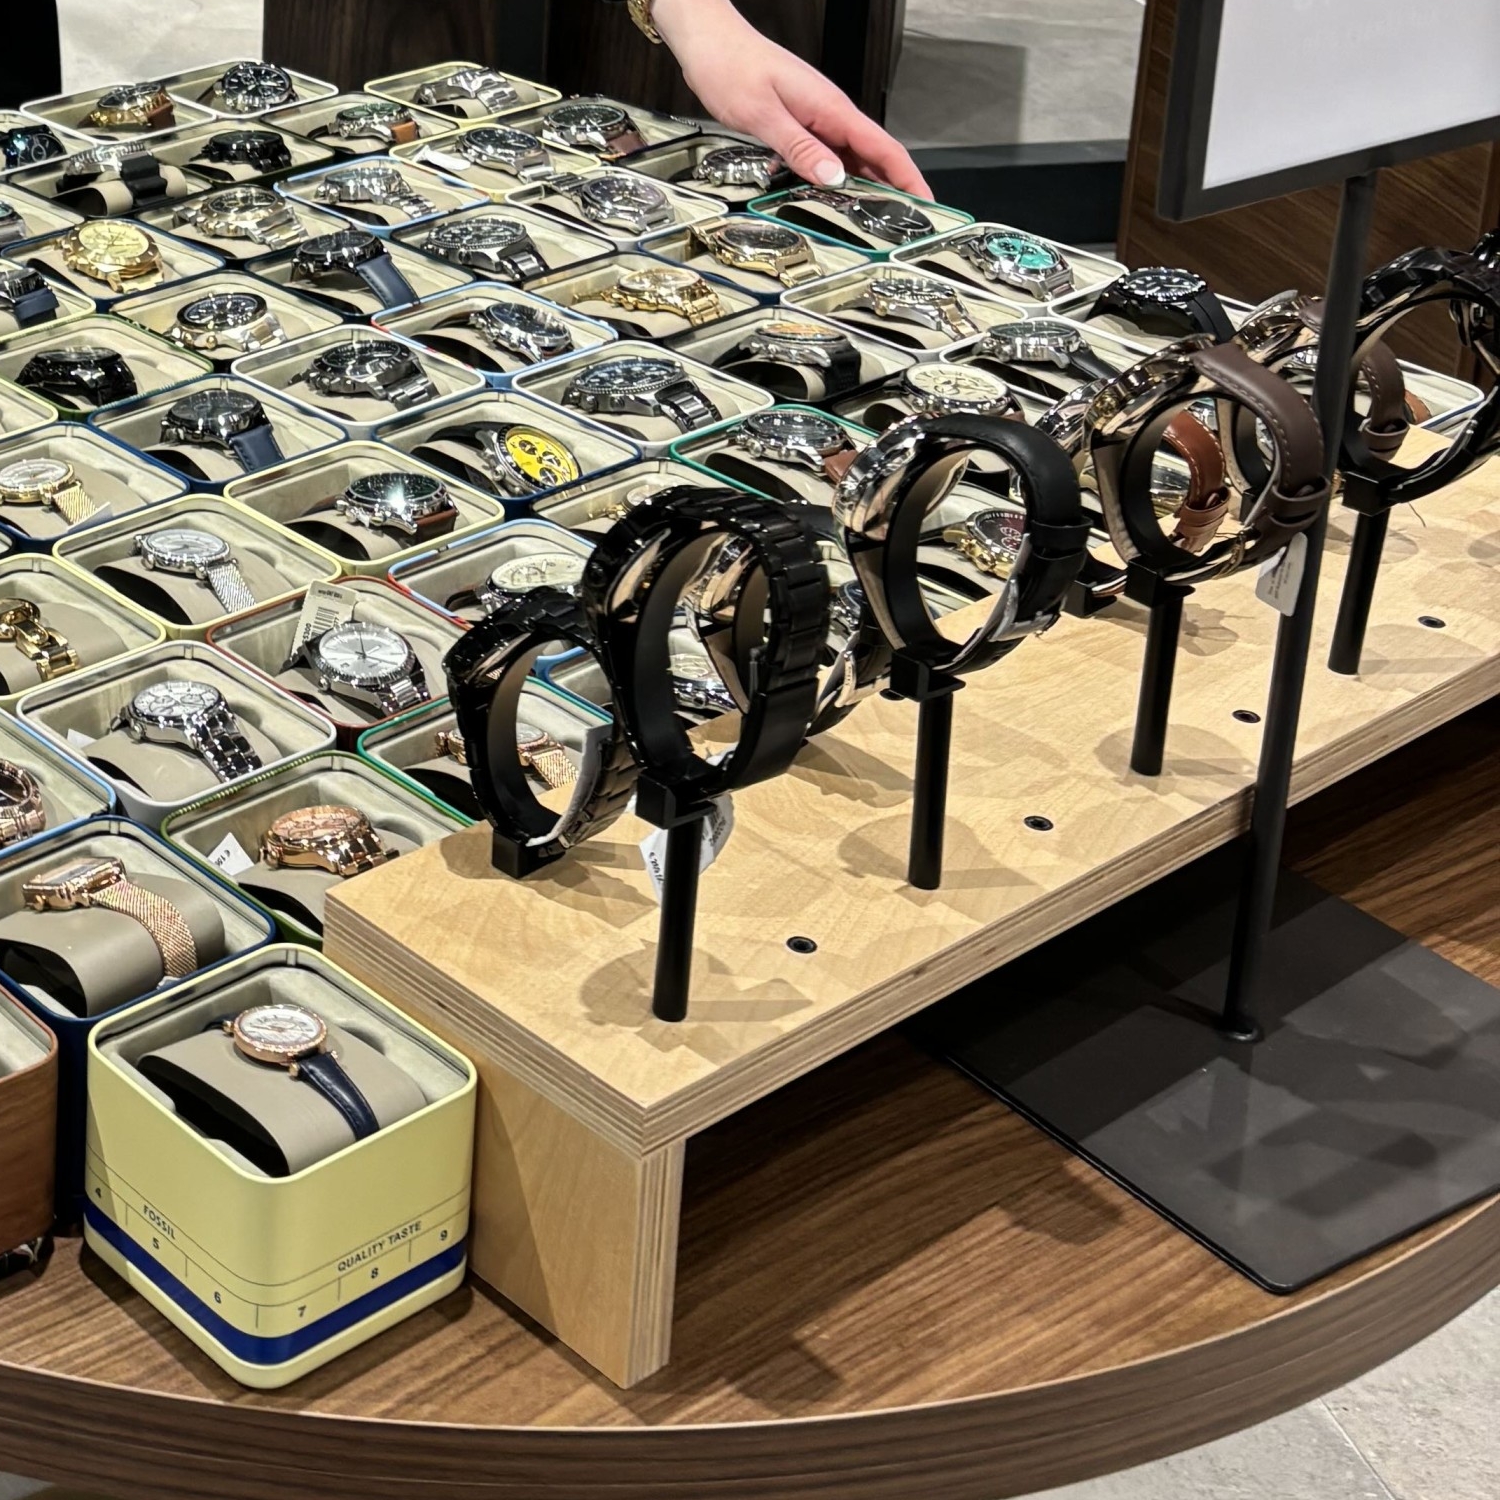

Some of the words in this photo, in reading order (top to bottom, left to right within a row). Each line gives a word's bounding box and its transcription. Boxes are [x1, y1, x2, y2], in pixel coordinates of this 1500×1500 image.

[143, 1204, 176, 1240] FOSSIL
[439, 1229, 449, 1242] 9
[152, 1236, 160, 1250] 5
[337, 1241, 386, 1272] QUALITY
[387, 1220, 422, 1246] TASTE
[370, 1267, 379, 1279] 8
[213, 1291, 222, 1305] 6
[297, 1304, 307, 1318] 7
